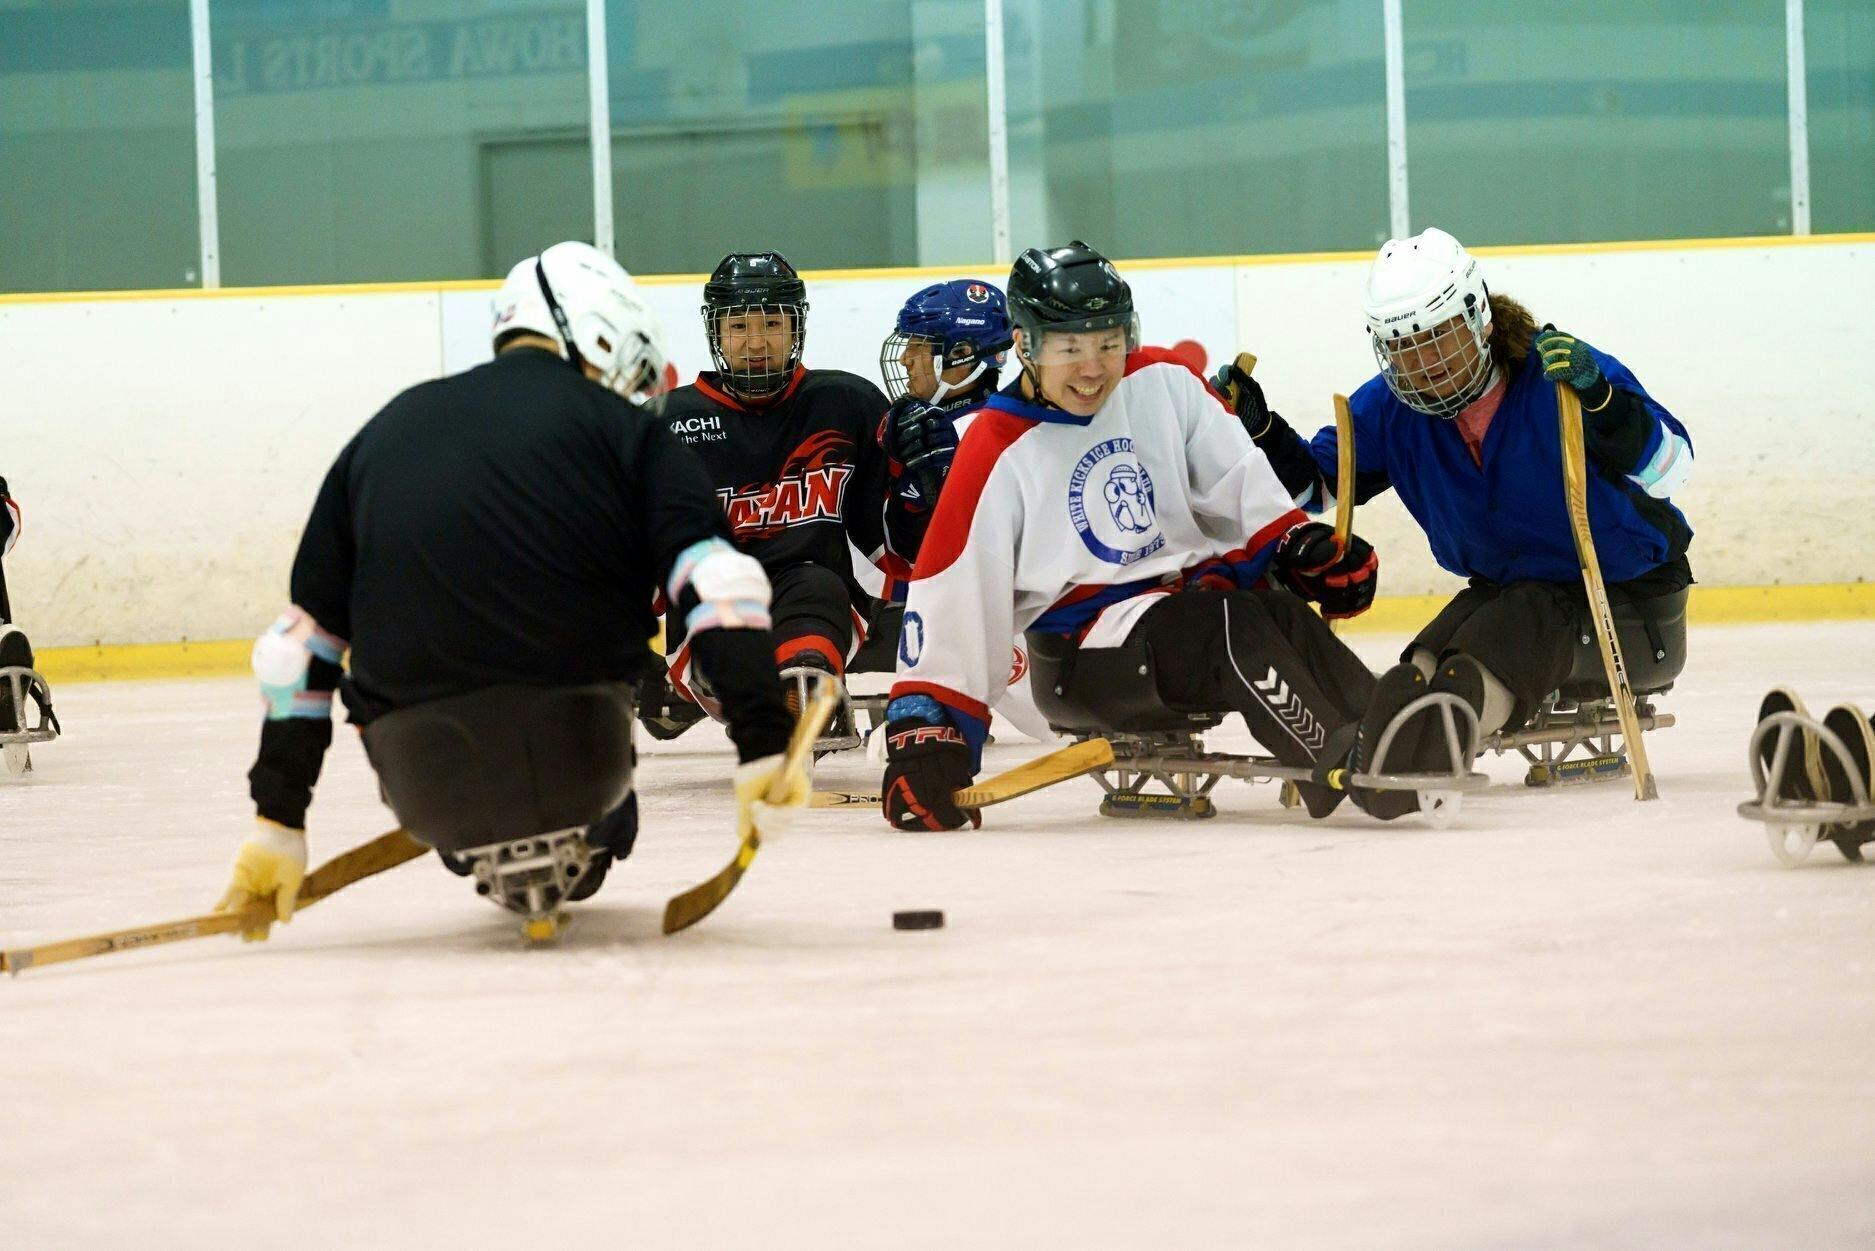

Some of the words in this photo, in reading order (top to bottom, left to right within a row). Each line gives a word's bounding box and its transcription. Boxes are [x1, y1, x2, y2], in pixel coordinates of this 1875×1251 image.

[955, 317, 985, 326] Nagano
[1384, 310, 1417, 324] BAUER
[670, 416, 720, 434] ACHI
[702, 431, 727, 441] Next
[1090, 443, 1112, 462] ICE
[1070, 457, 1094, 492] KICKS
[1069, 495, 1089, 533] WHITE
